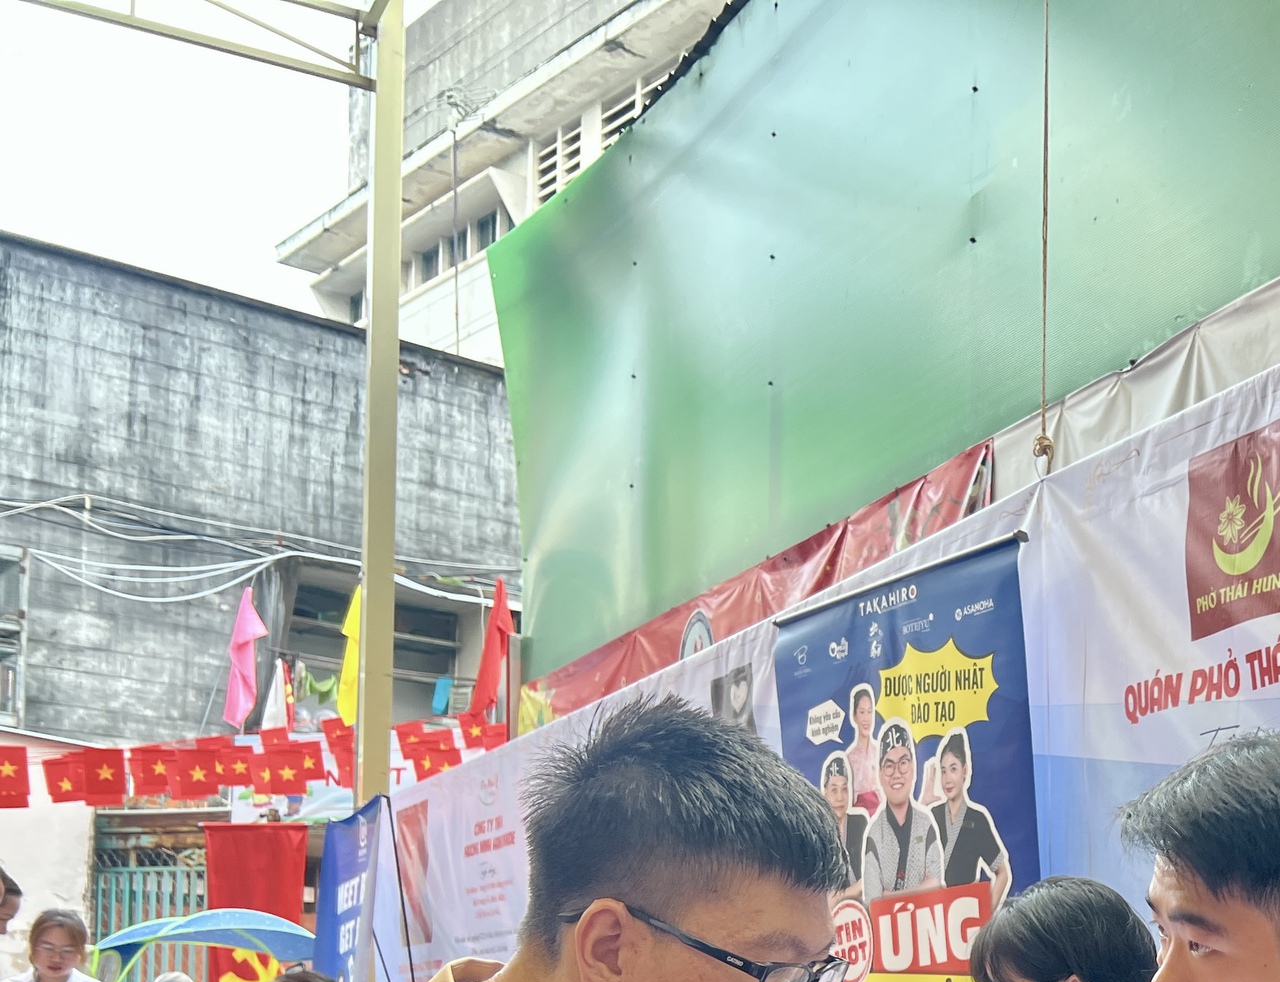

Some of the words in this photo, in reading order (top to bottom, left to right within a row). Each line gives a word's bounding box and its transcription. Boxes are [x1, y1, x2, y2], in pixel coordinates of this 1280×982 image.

[859, 584, 918, 616] TAKAHIRO
[1219, 579, 1248, 605] THÁI
[884, 676, 913, 701] ĐƯỢC
[915, 665, 951, 693] NGƯỜI
[955, 663, 985, 694] NHẬT
[1124, 669, 1182, 724] QUÁN
[1188, 648, 1240, 704] PHỞ
[911, 697, 930, 724] ĐÀO
[934, 701, 955, 727] TẠO
[836, 917, 864, 945] TIN
[878, 896, 981, 972] ỨNG
